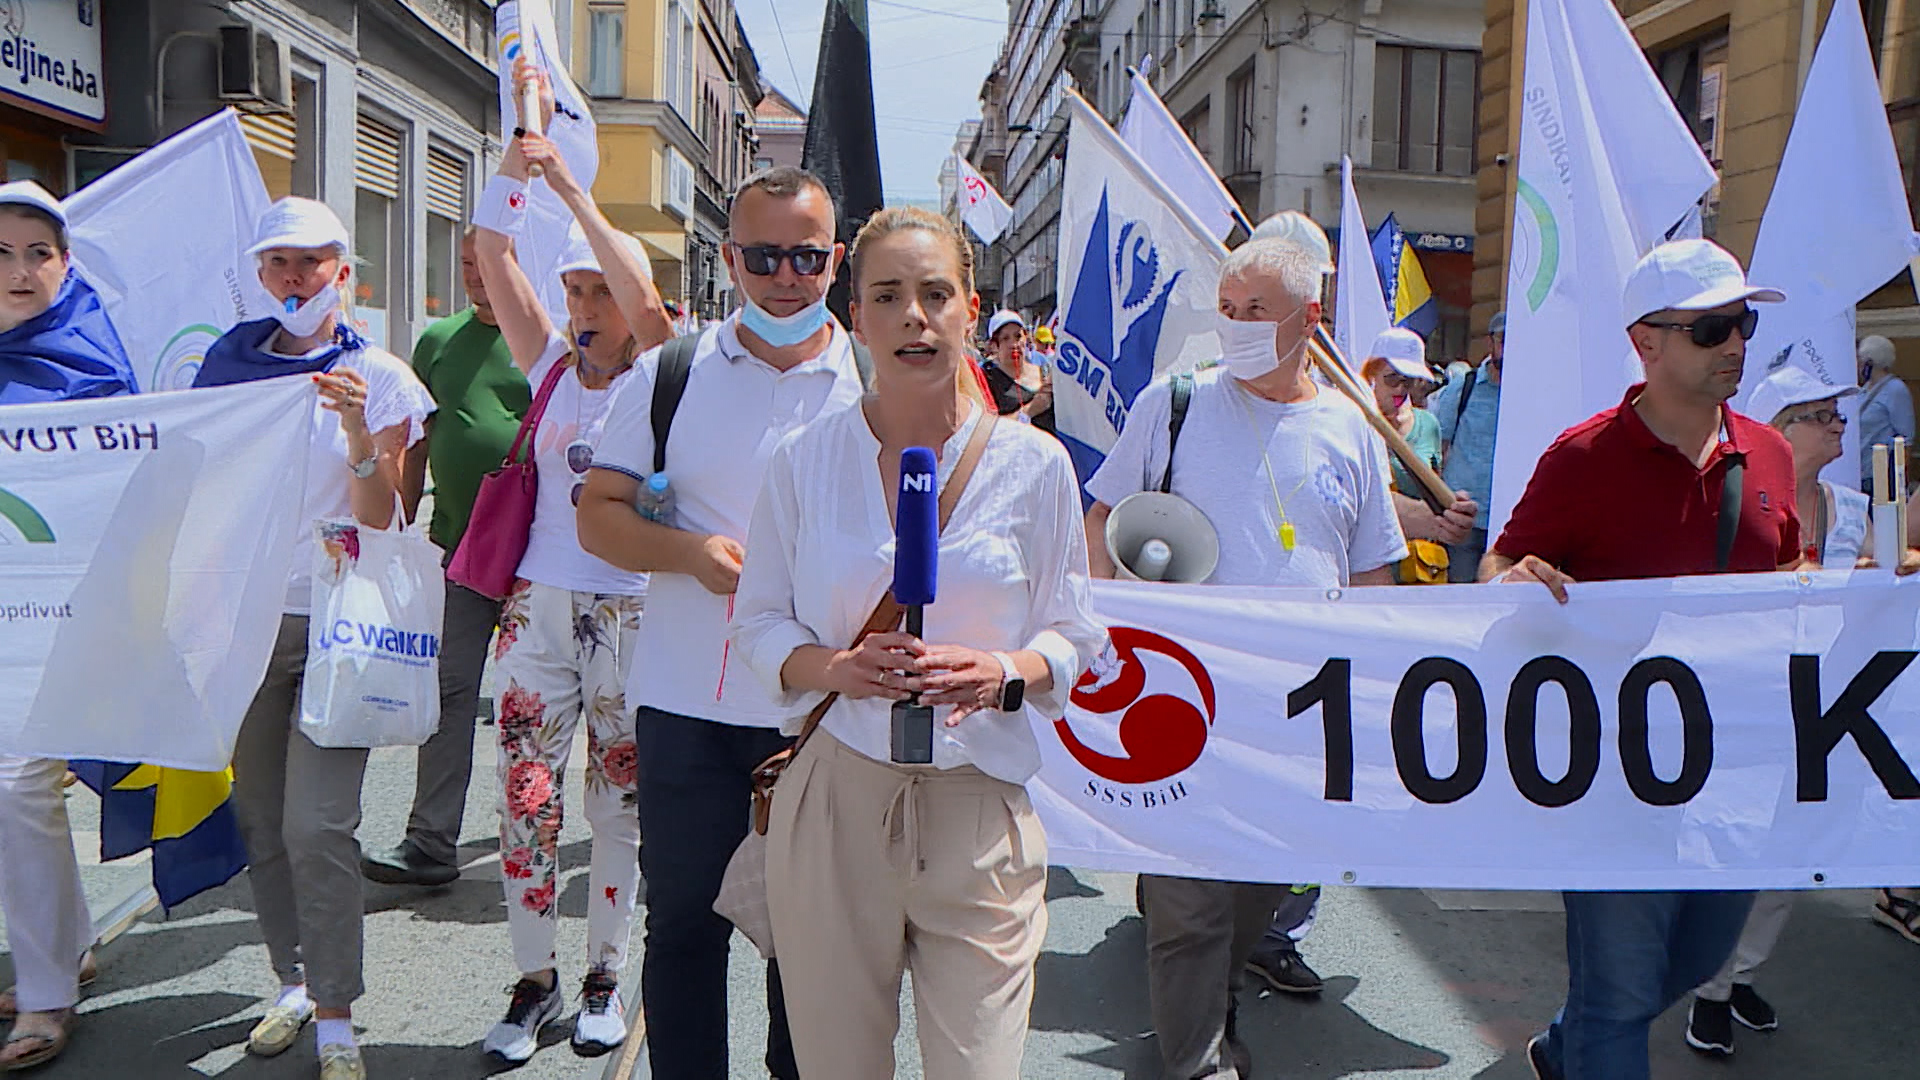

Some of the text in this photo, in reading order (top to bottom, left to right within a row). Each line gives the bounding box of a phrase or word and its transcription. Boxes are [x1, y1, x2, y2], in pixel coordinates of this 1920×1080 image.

[1, 36, 98, 98] eljine.ba
[1057, 341, 1105, 400] SM
[94, 422, 158, 450] BiH
[903, 472, 931, 492] N1
[1287, 651, 1920, 808] 1000 K
[1083, 779, 1191, 808] SSS BiH
